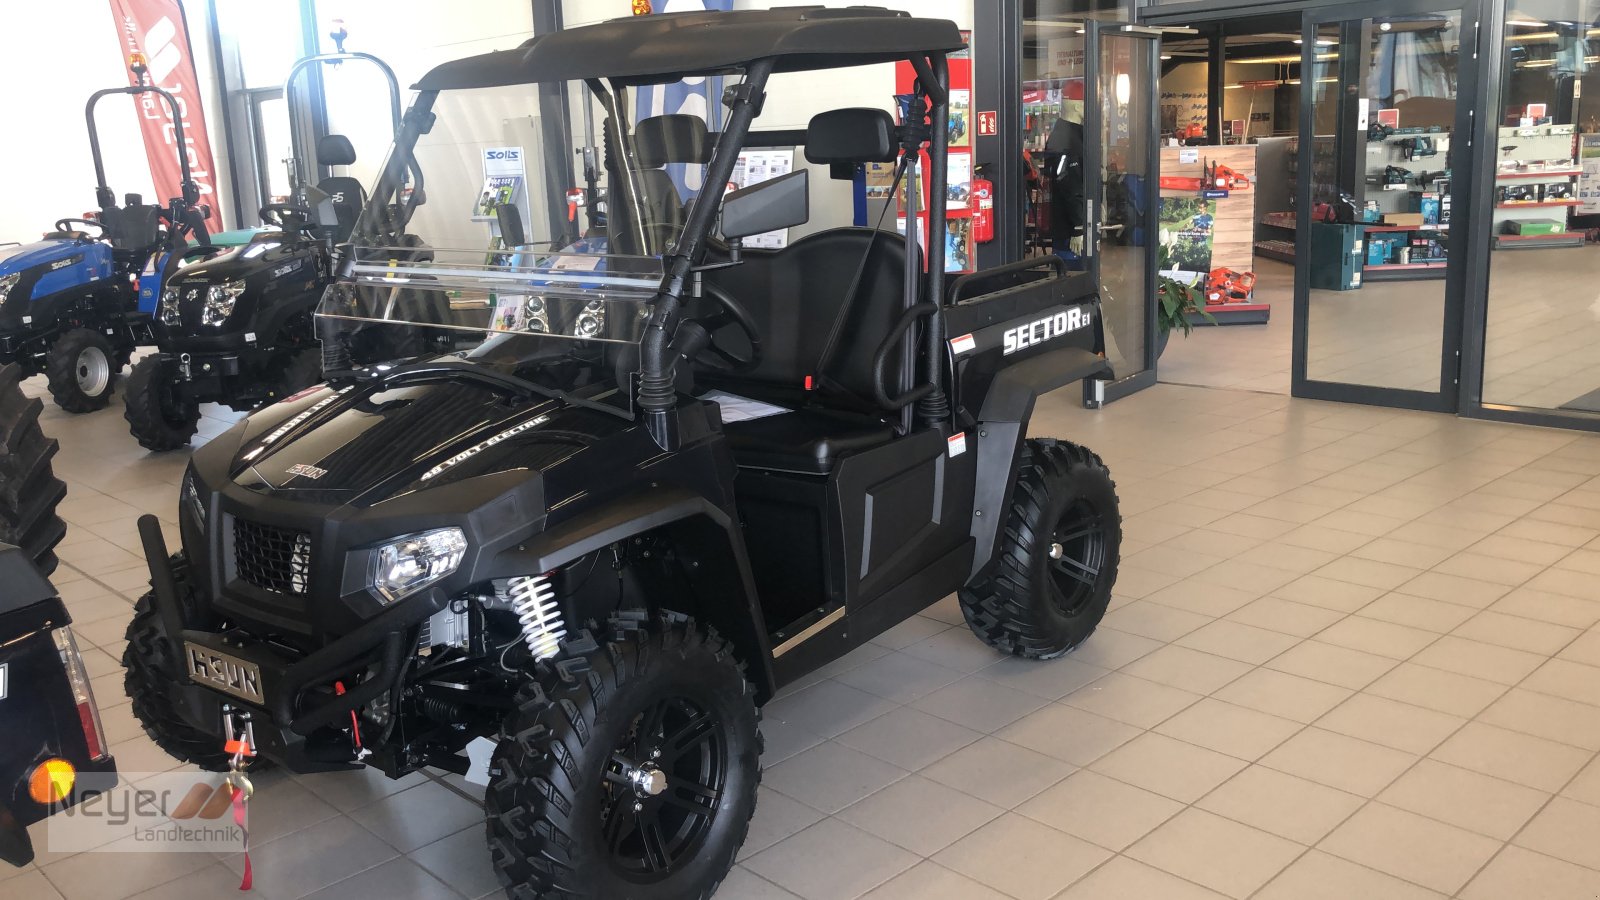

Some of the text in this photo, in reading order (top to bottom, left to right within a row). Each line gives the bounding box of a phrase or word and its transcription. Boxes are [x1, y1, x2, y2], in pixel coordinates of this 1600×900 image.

[1003, 306, 1083, 356] SECTOR
[262, 411, 313, 444] ELECTRIC
[420, 414, 551, 481] 48 VOLT ELECTRIC
